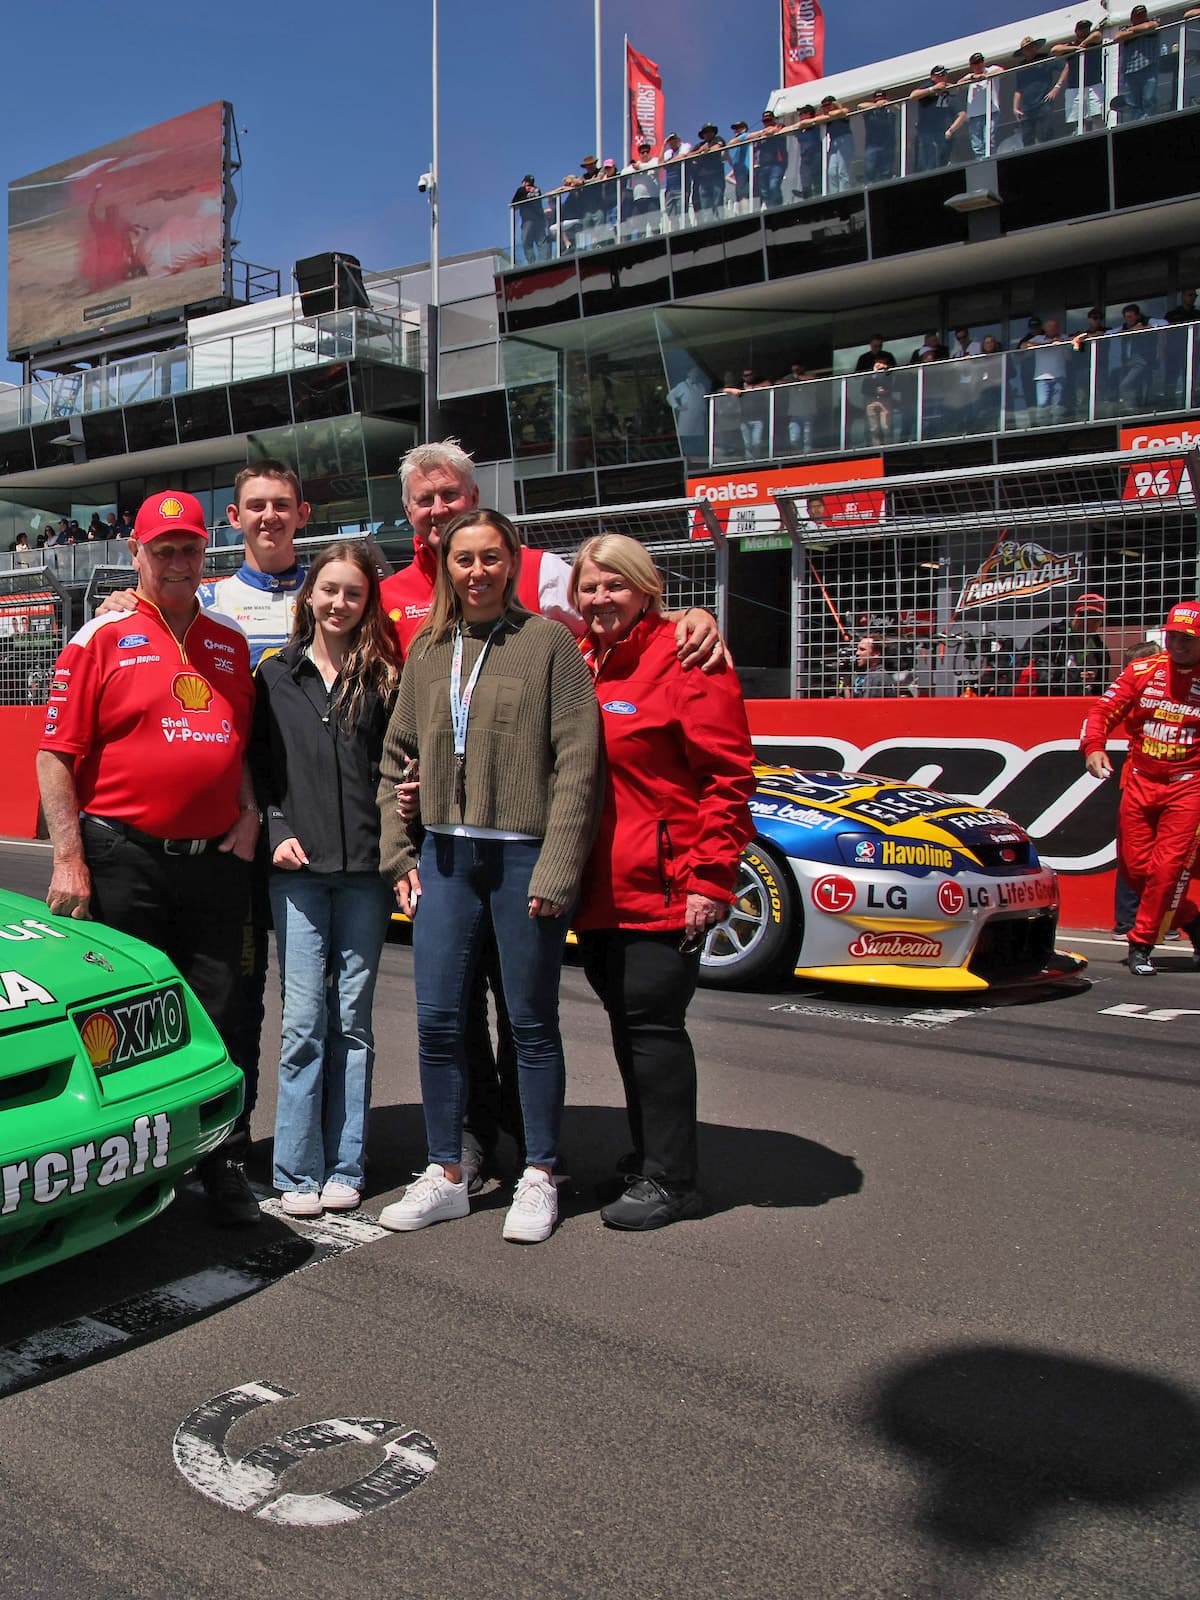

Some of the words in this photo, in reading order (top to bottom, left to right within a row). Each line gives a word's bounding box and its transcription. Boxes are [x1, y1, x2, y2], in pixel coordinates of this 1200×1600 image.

[694, 481, 759, 503] Coates
[1134, 469, 1171, 497] 96
[736, 509, 756, 520] SMITH
[736, 521, 757, 532] EVANS
[744, 536, 784, 549] Merlin
[1172, 615, 1194, 625] SUPER
[1174, 609, 1192, 617] MAKE
[1192, 610, 1199, 618] IT
[161, 717, 189, 728] Shell
[1143, 720, 1179, 743] MAKE
[1179, 727, 1196, 745] IT
[163, 728, 230, 744] V-Power
[880, 841, 953, 868] Havoline
[746, 854, 782, 923] DUNLOP
[867, 884, 908, 910] LG
[968, 886, 989, 908] LG
[999, 880, 1034, 907] Life's
[850, 931, 942, 957] Sunbeam
[113, 990, 184, 1063] XMO
[171, 1379, 440, 1527] 6
